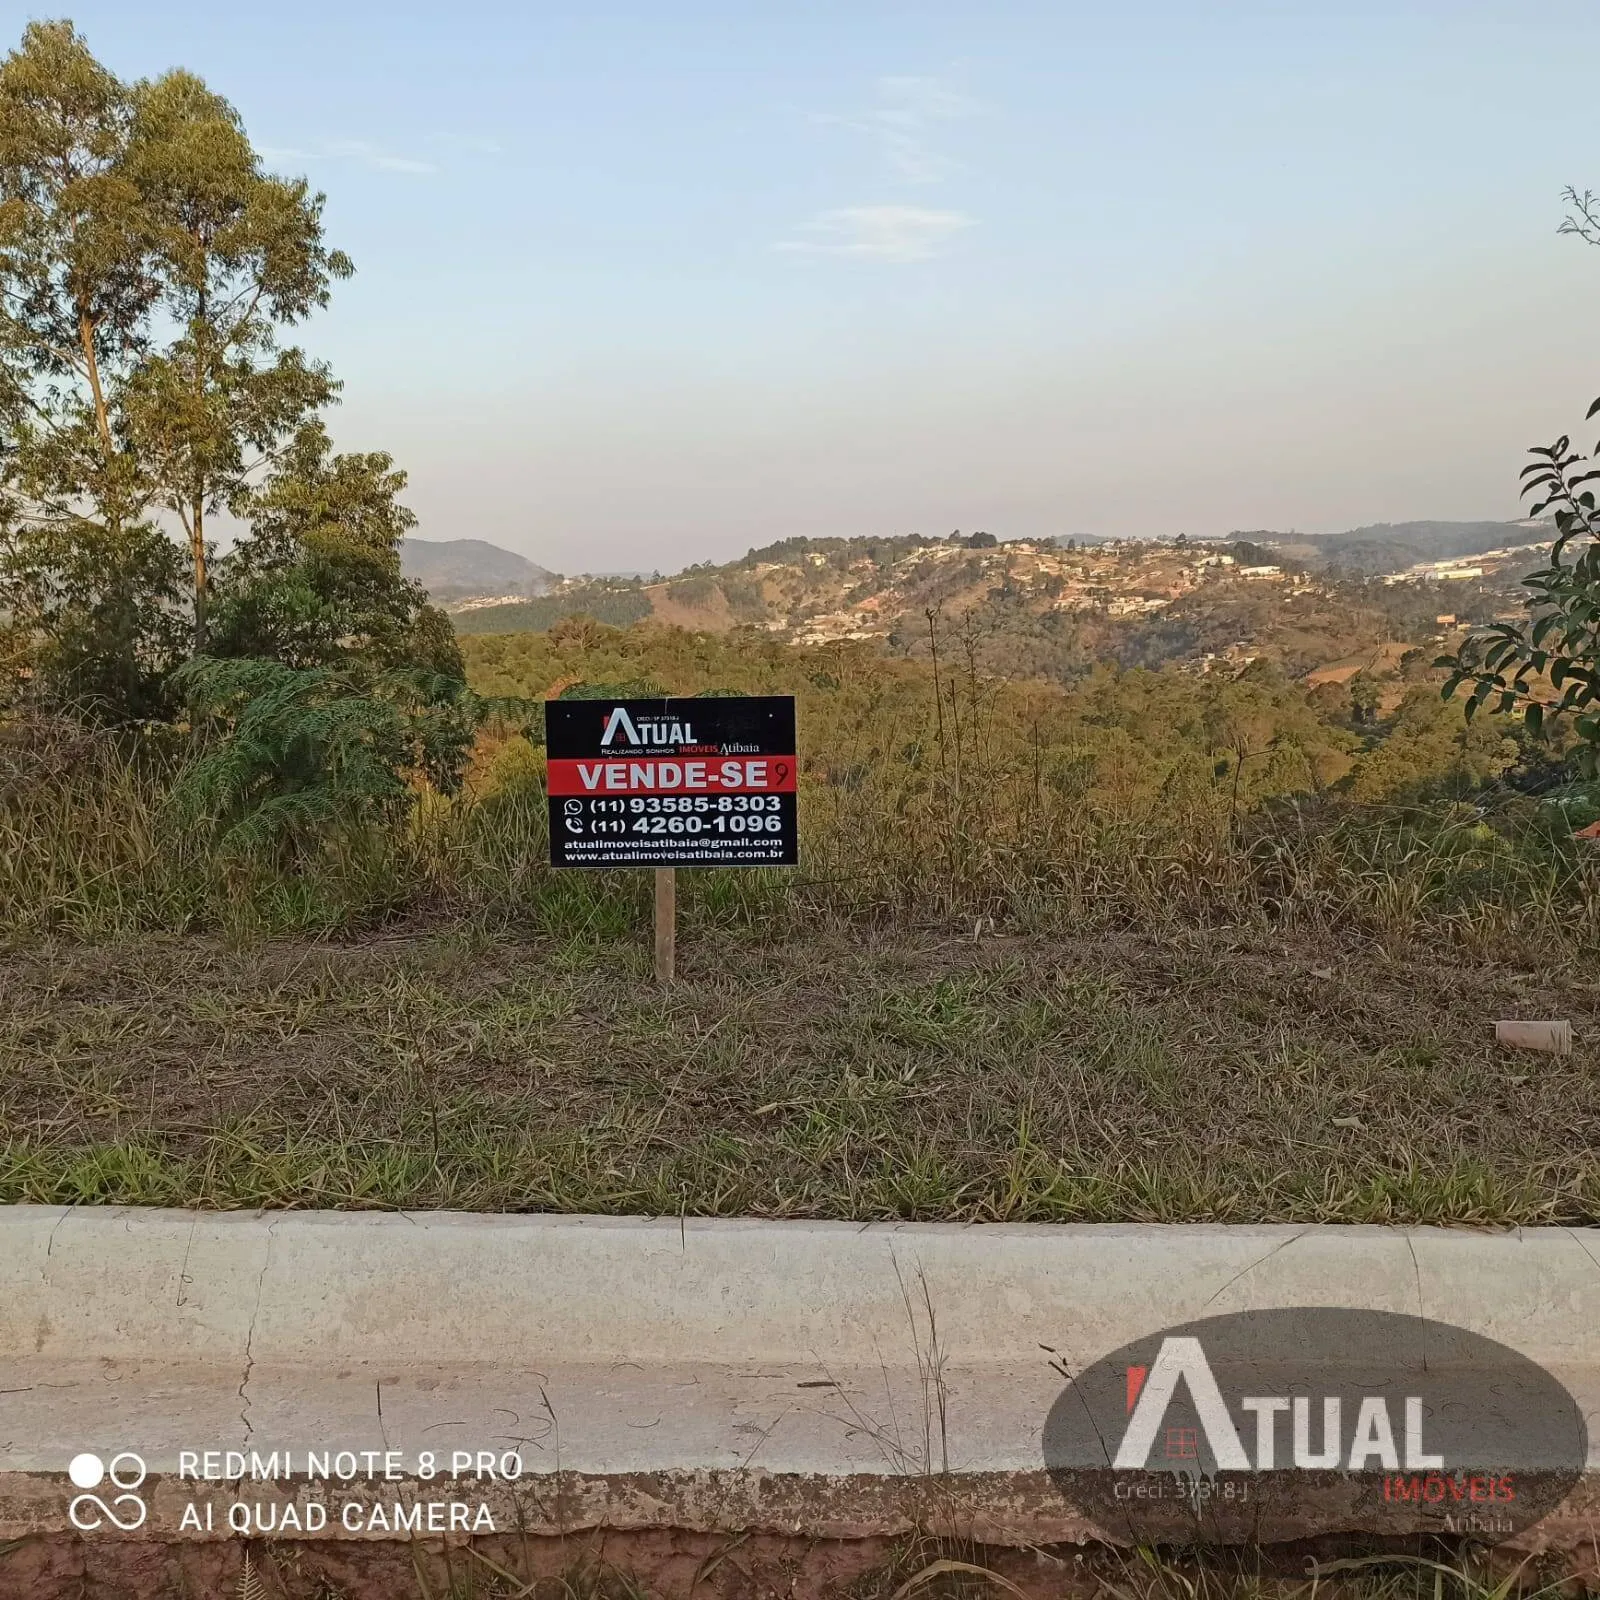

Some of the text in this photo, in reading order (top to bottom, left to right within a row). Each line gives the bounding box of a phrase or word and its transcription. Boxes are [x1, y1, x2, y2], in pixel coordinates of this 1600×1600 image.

[600, 707, 698, 745] ATUAL
[679, 744, 718, 753] IMÓVEIS
[720, 742, 760, 755] Atibaia
[577, 761, 768, 790] VENDE-SE
[590, 795, 781, 814] (11) 93585-8303
[591, 815, 782, 834] (11) 4260-1096
[565, 838, 783, 850] atualimoveisatibaia@gmail.com
[565, 849, 784, 862] www.atualimoveisatibaia.com.br
